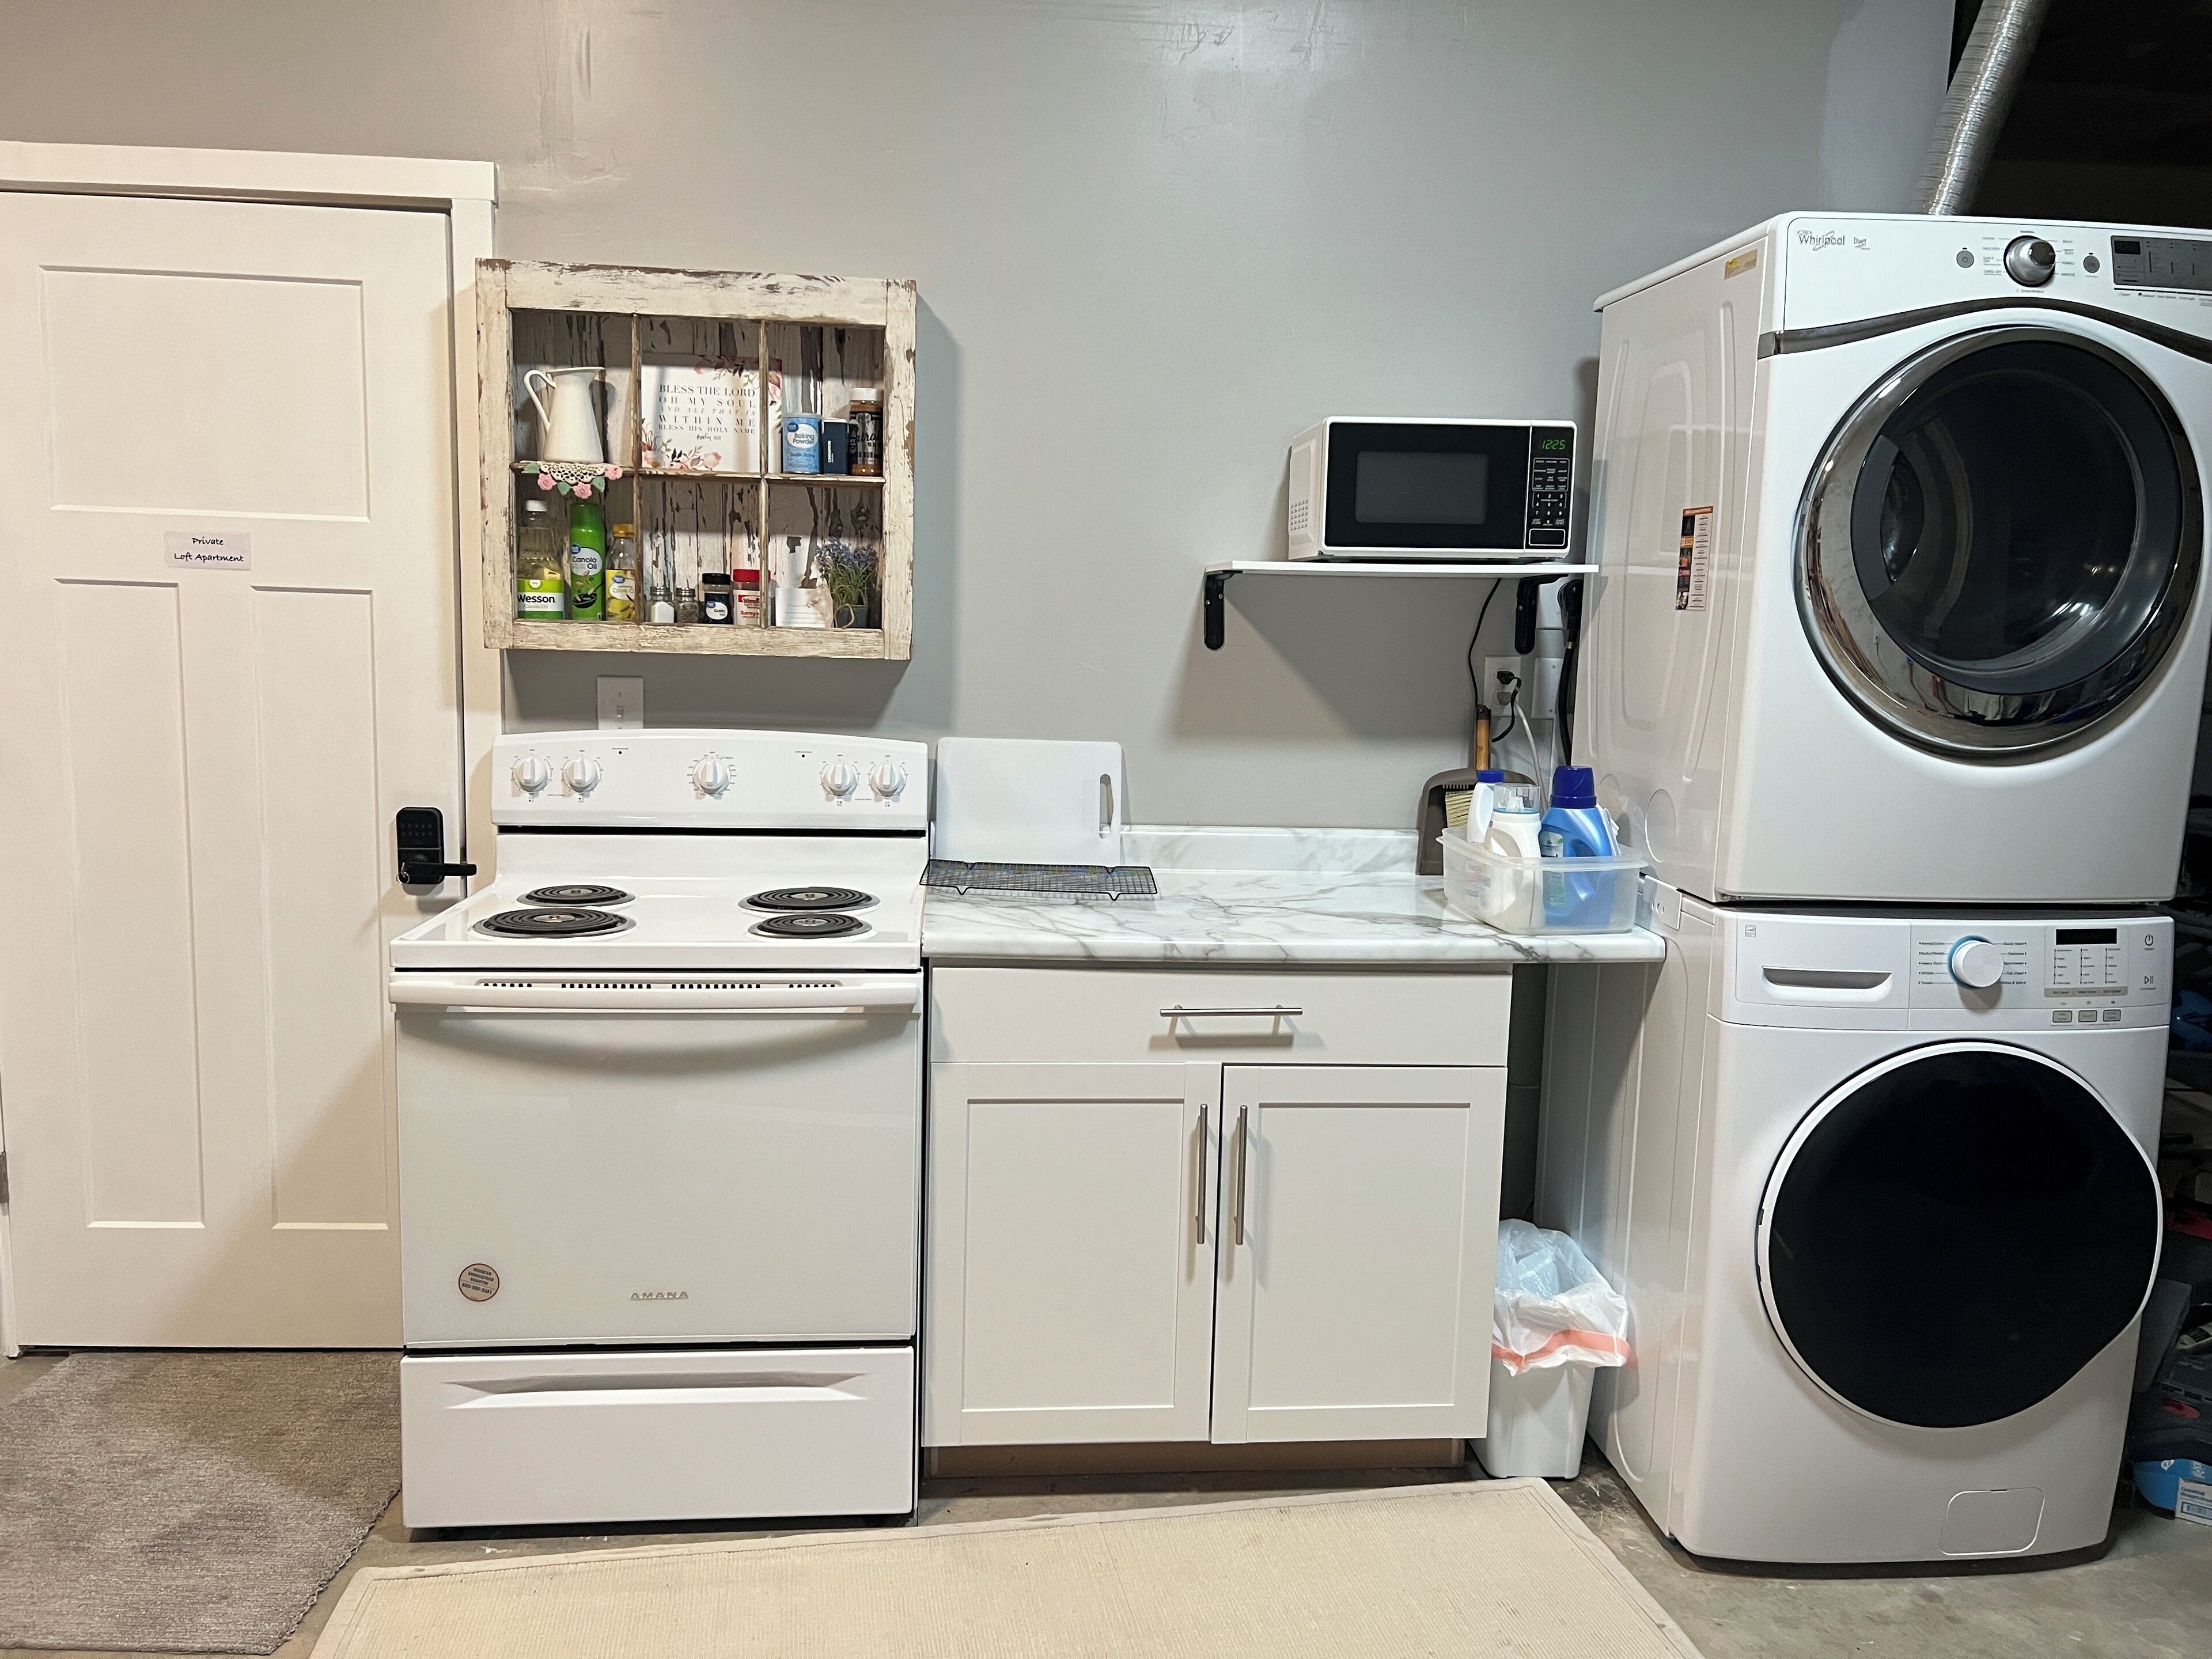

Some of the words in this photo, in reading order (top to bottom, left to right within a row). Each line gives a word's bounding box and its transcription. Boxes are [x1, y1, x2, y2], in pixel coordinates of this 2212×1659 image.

[1798, 233, 1845, 248] Whirlpool
[660, 384, 694, 394] BLESS
[697, 386, 720, 395] THE
[725, 388, 755, 397] LORD
[689, 397, 705, 405] MY
[717, 399, 755, 408] SOUL
[659, 415, 722, 425] WITHIN
[736, 419, 755, 427] ME
[192, 536, 224, 546] Private
[174, 552, 192, 562] Loft
[195, 554, 244, 563] Apartment
[517, 594, 555, 603] Wesson
[630, 1291, 688, 1300] AMANA
